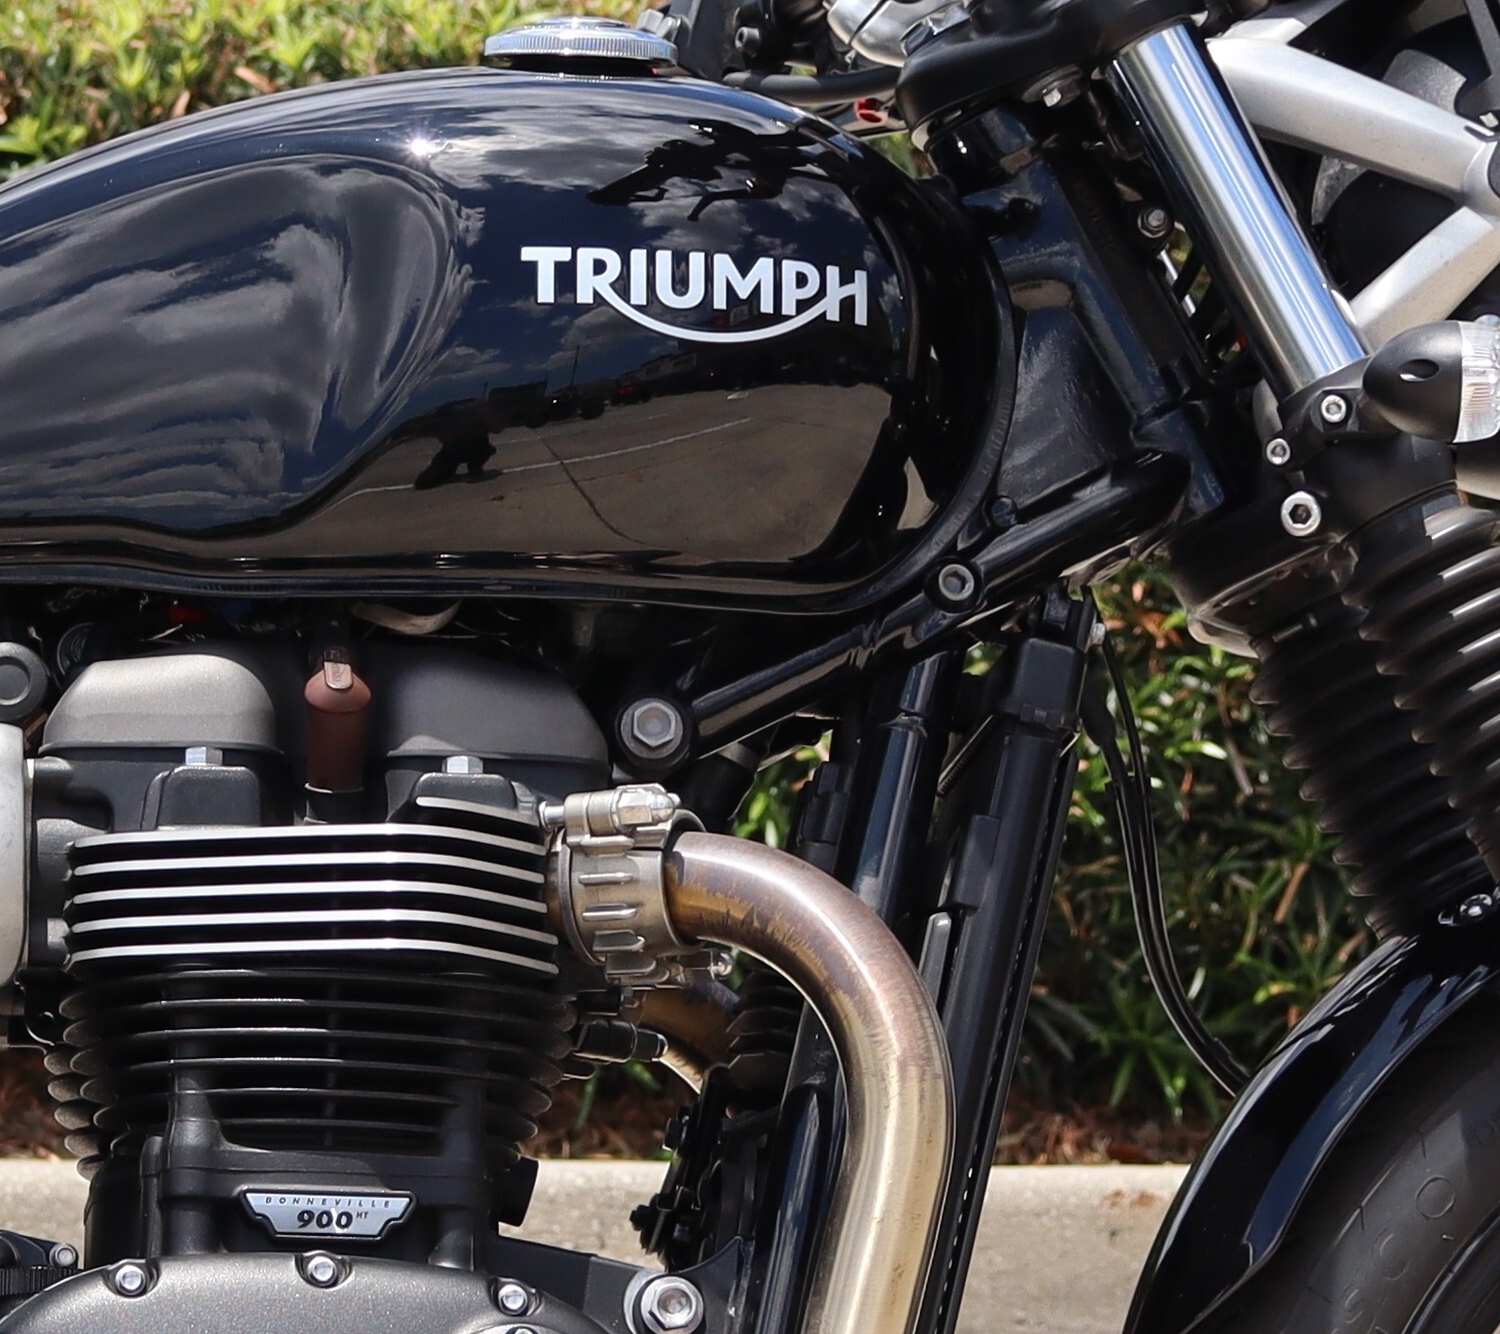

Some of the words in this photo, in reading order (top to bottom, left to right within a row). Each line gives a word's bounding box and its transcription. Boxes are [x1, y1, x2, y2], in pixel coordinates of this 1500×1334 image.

[520, 246, 868, 343] TRIUMPH
[264, 1196, 392, 1209] BONNEVILLE
[296, 1210, 353, 1230] 900
[355, 1211, 370, 1221] HT
